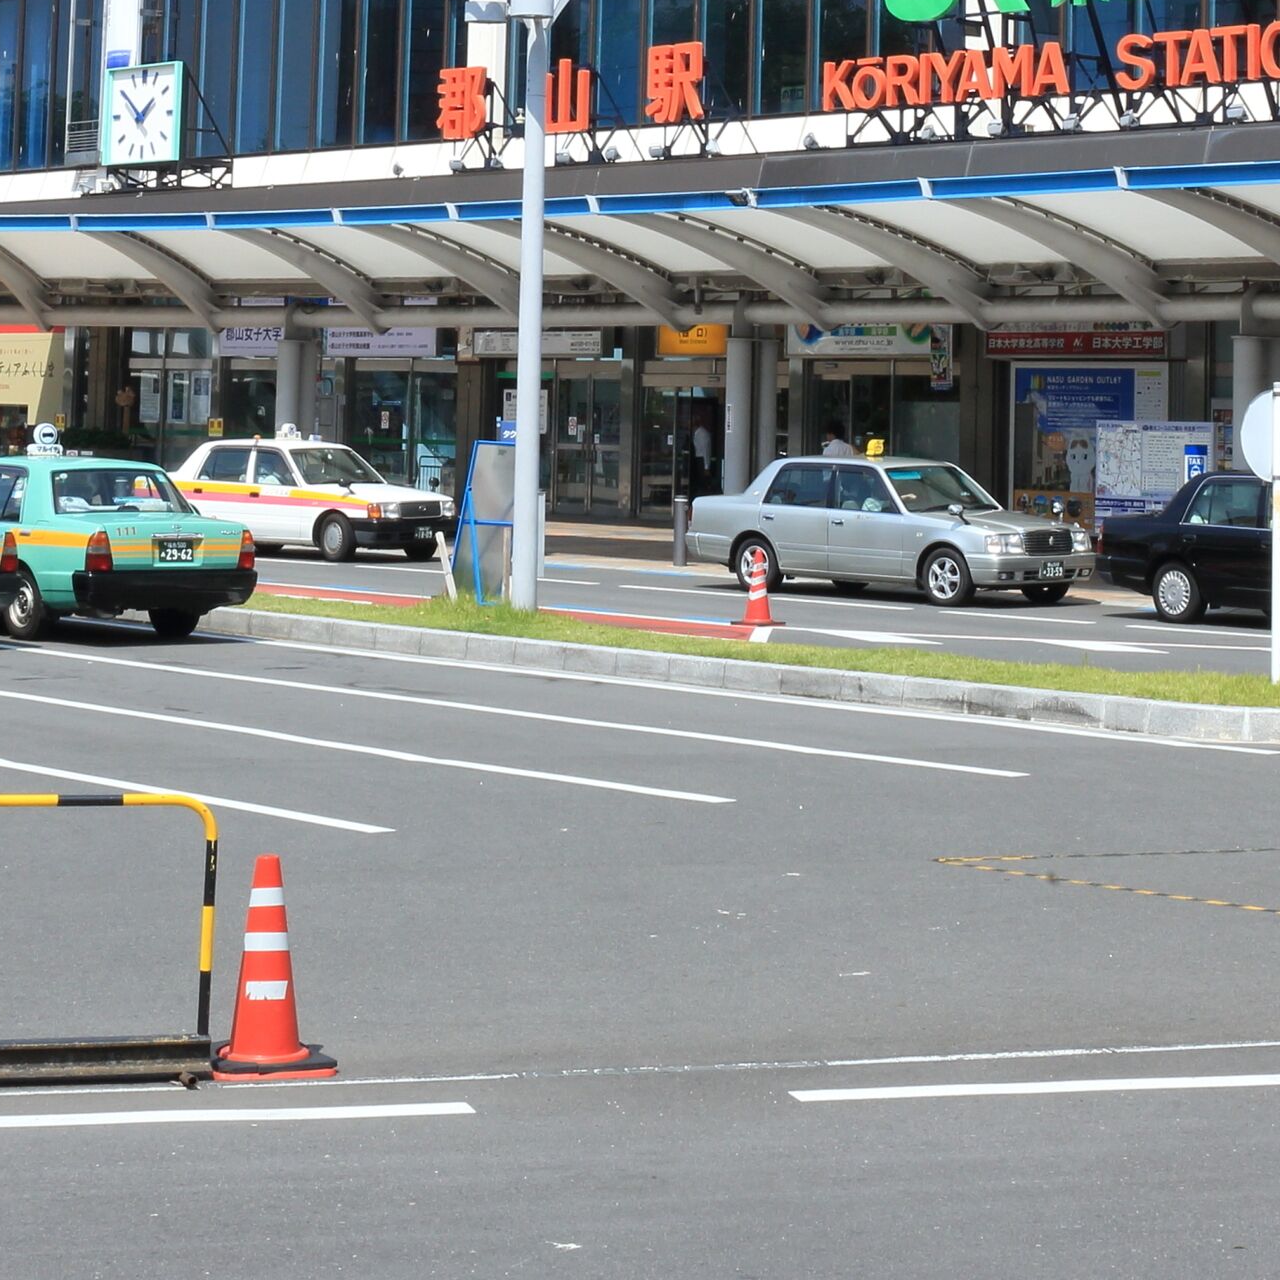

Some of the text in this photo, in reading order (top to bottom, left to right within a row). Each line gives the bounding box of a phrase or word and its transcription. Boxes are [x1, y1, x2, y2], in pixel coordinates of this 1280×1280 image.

[988, 337, 1064, 349] 日本大学東北高等学校
[1092, 336, 1164, 350] 日本大学工学部
[1096, 376, 1122, 384] OUTLET
[117, 526, 136, 536] 111
[166, 549, 193, 561] 29-62
